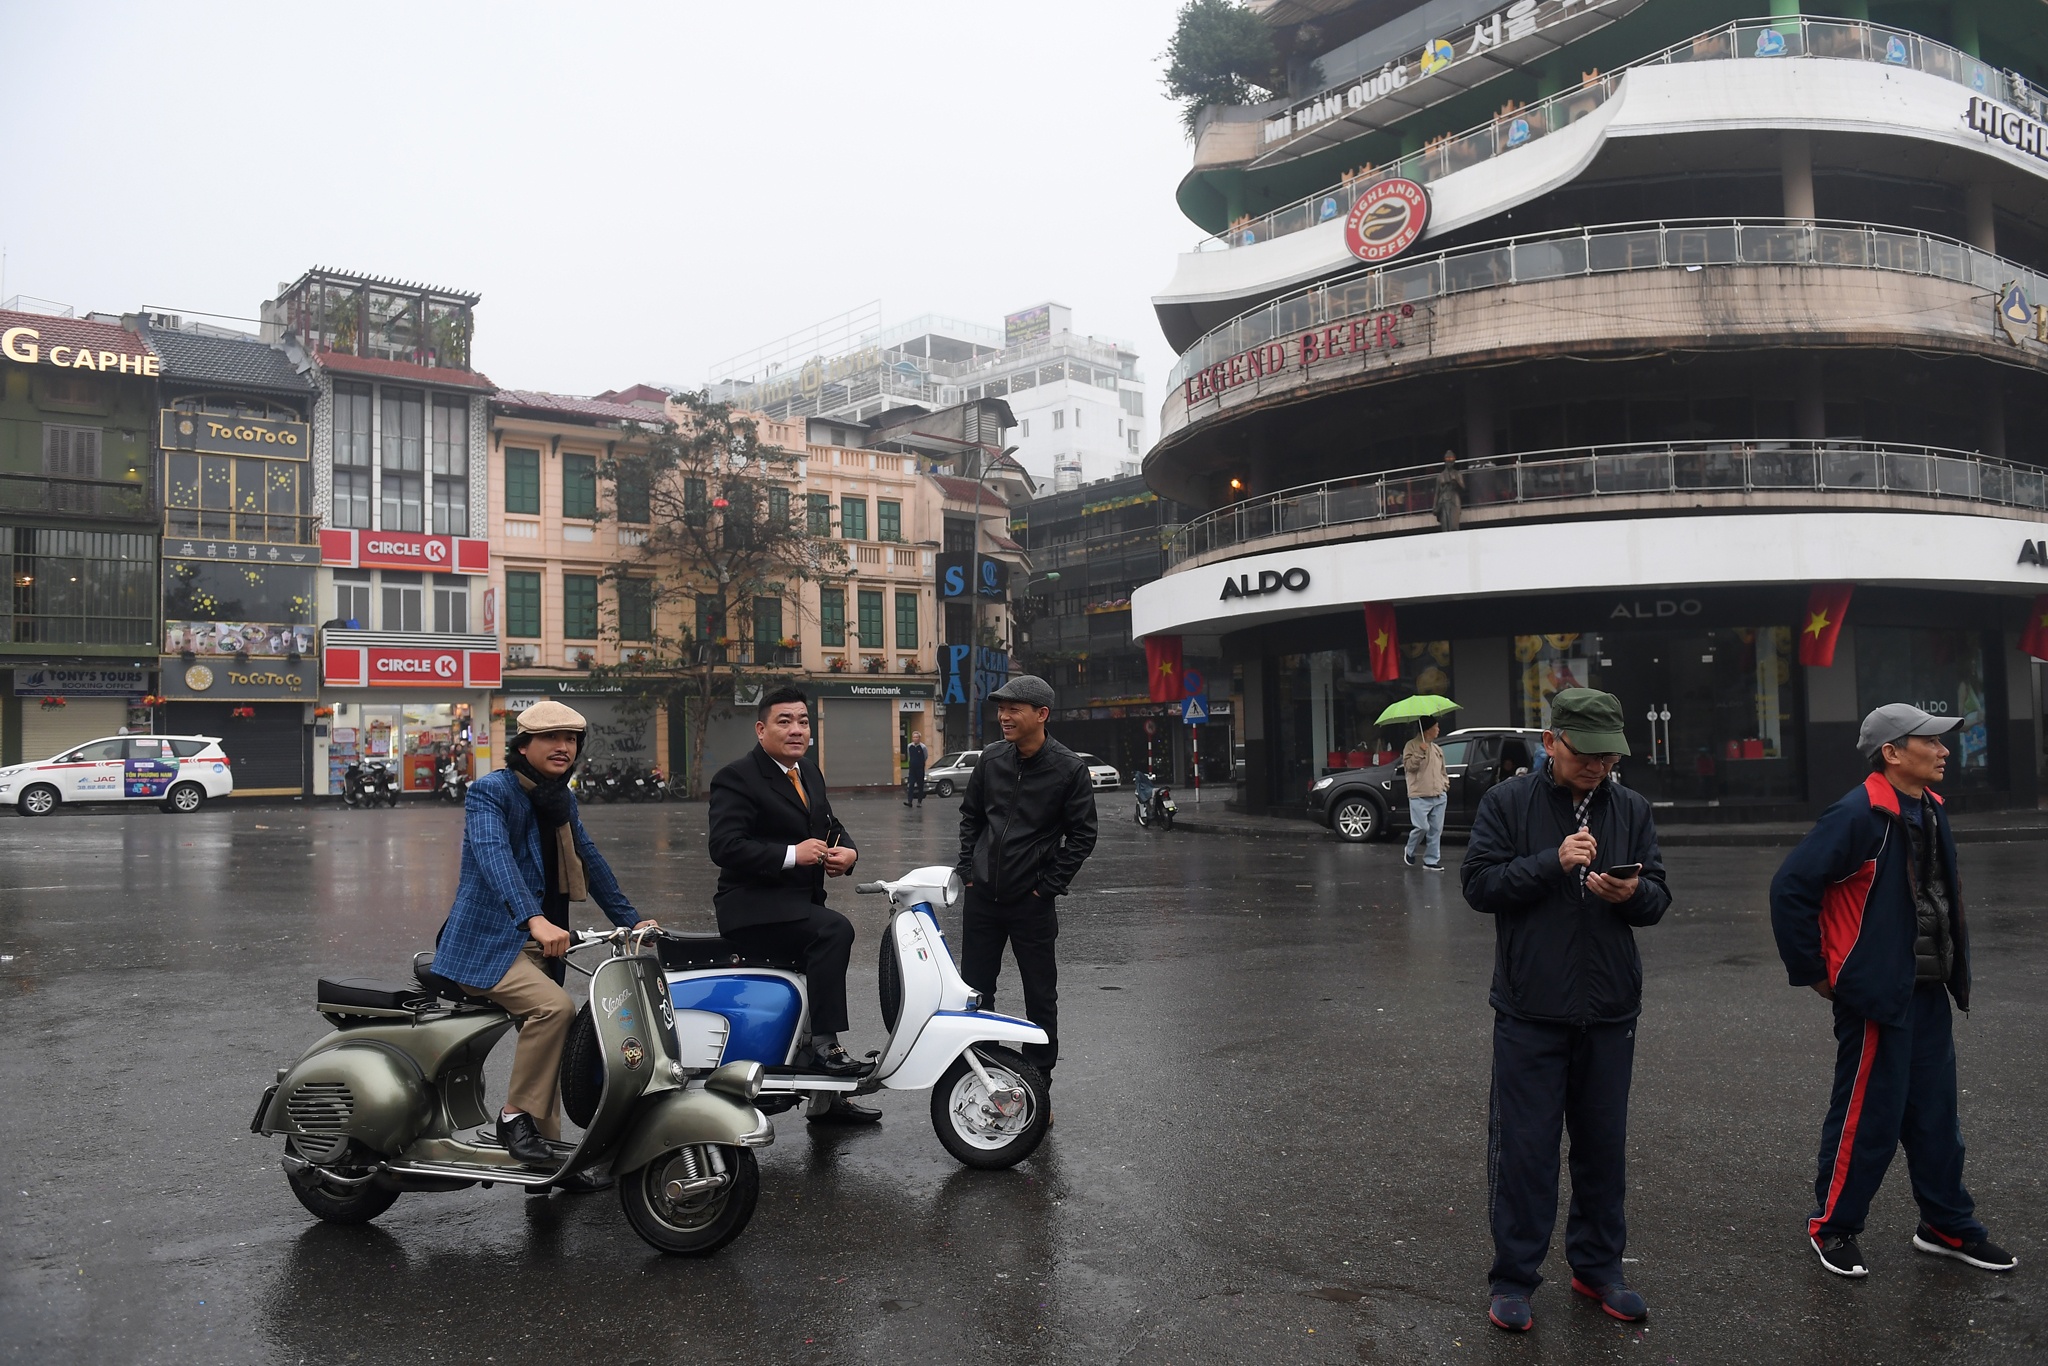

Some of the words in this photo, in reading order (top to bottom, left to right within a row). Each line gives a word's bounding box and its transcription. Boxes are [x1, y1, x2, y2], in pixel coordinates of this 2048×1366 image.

[1264, 111, 1292, 144] MÌ
[1296, 95, 1343, 131] HÀN
[1347, 62, 1409, 108] QUỐC
[1349, 183, 1421, 229] HIGHLANDS
[1359, 227, 1415, 258] COFFEE
[2, 327, 40, 364] G
[829, 345, 881, 383] HOTEL
[1185, 343, 1284, 406] LEGEND
[1299, 313, 1400, 366] BEER
[367, 540, 420, 556] CIRCLE
[1219, 567, 1310, 600] ALDO
[1610, 599, 1702, 619] ALDO
[49, 671, 96, 682] TONY'S
[101, 672, 142, 682] TOURS
[377, 658, 431, 673] CIRCLE
[851, 685, 901, 695] Vietcombank
[512, 700, 534, 708] ATM
[1914, 701, 1948, 713] ALDO
